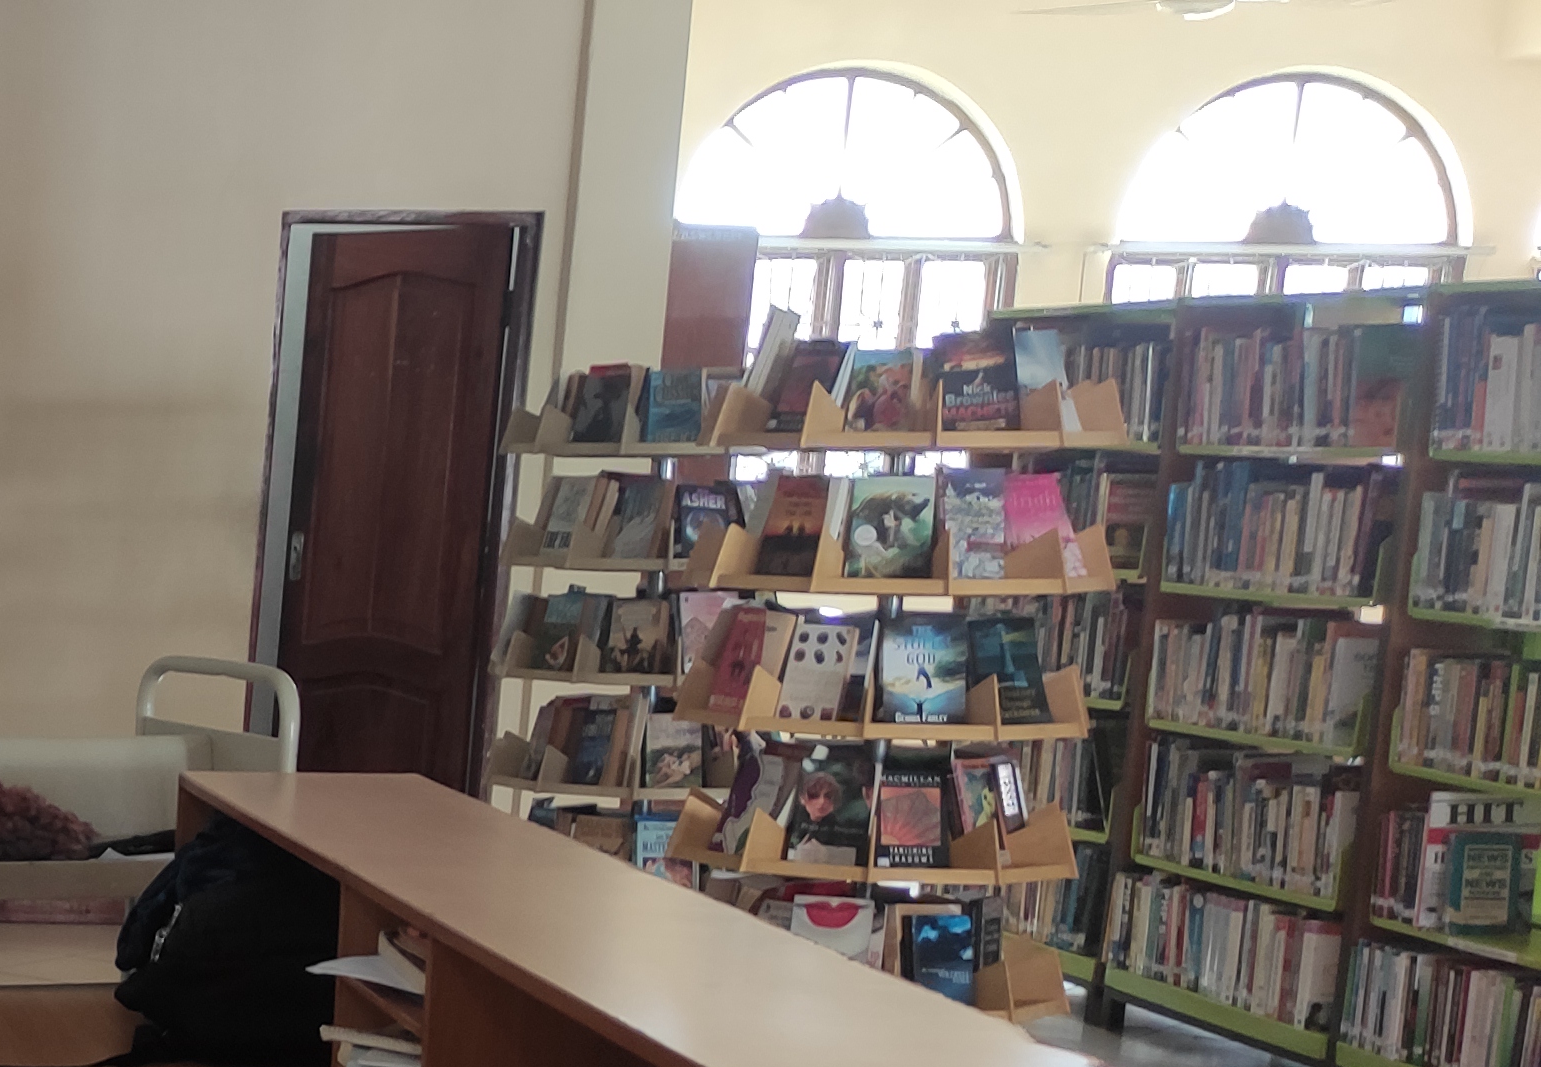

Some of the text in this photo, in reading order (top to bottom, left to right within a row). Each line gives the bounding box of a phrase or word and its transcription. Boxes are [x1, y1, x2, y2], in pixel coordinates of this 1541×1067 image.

[963, 383, 991, 396] Nick
[681, 490, 726, 510] ASHER
[880, 773, 941, 783] MACMILLAN
[1447, 799, 1524, 824] HIT
